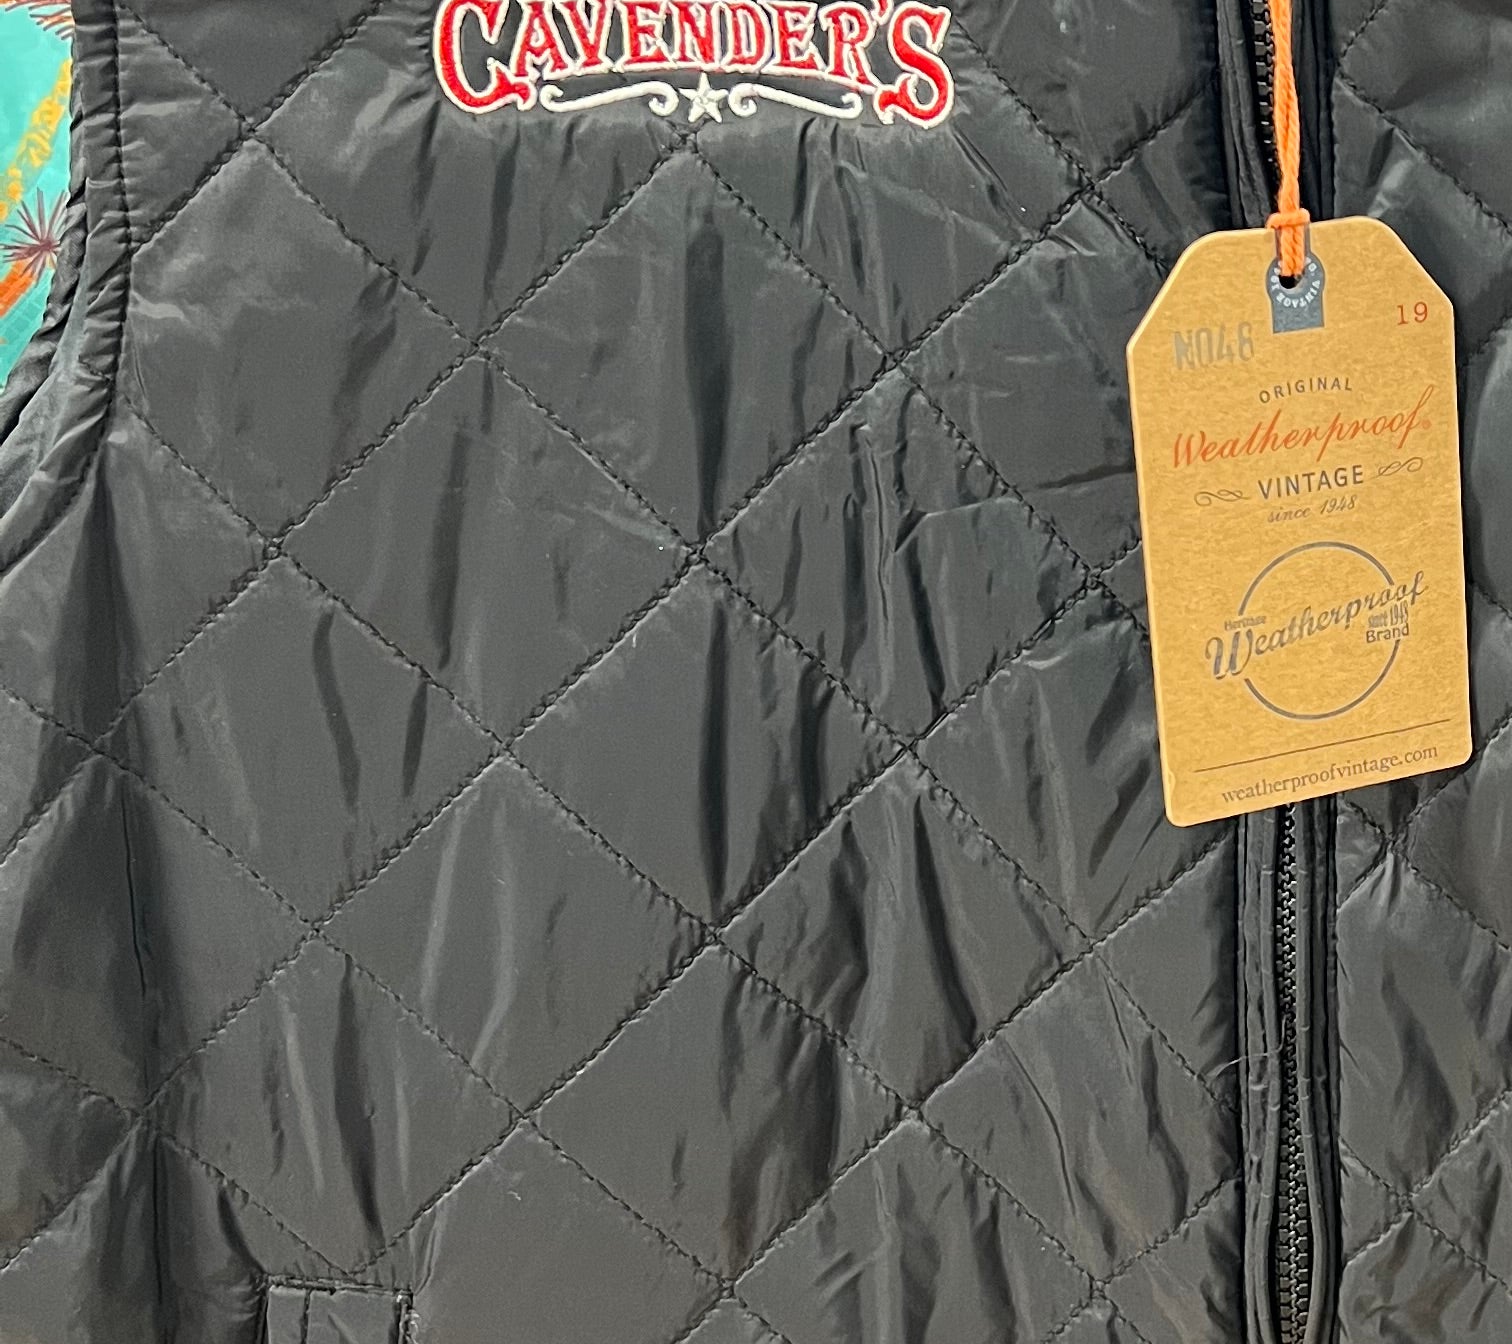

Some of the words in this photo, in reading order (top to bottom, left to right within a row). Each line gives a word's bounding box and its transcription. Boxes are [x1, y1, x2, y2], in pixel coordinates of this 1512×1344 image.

[1396, 302, 1429, 325] 19
[1259, 377, 1353, 404] ORIGINAL
[1258, 464, 1364, 500] VINTAGE
[1267, 506, 1311, 523] since
[1320, 495, 1357, 515] 1948
[1206, 570, 1429, 680] Weatherproof
[1366, 623, 1409, 643] Brand
[1221, 746, 1438, 804] weatherproofvintage.com
